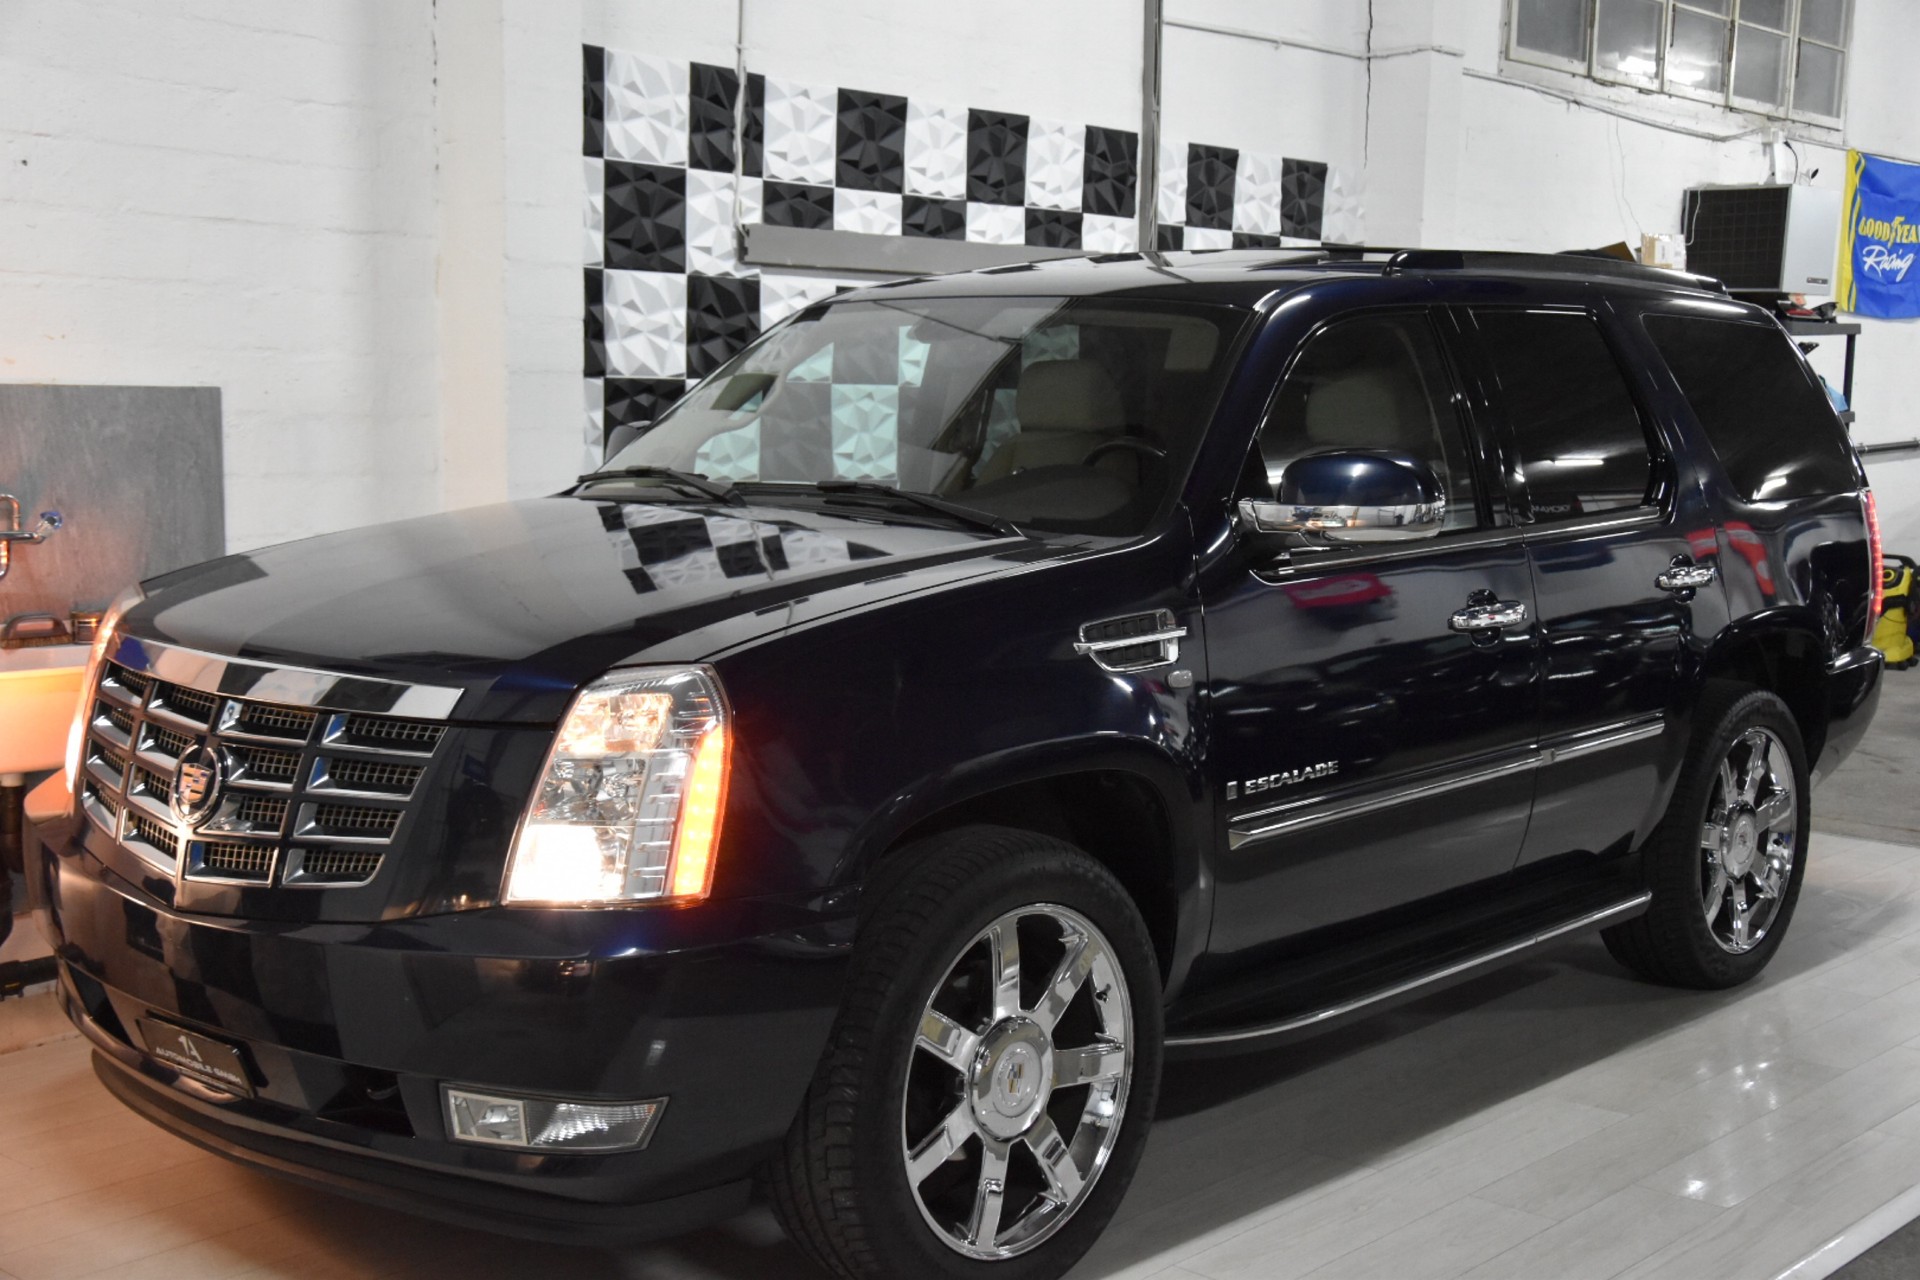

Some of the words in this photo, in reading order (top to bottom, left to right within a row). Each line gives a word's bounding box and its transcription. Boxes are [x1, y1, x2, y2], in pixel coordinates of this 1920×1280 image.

[1858, 216, 1920, 247] GOODYEA
[1863, 245, 1915, 282] Racing
[1244, 760, 1339, 795] ESCALADE
